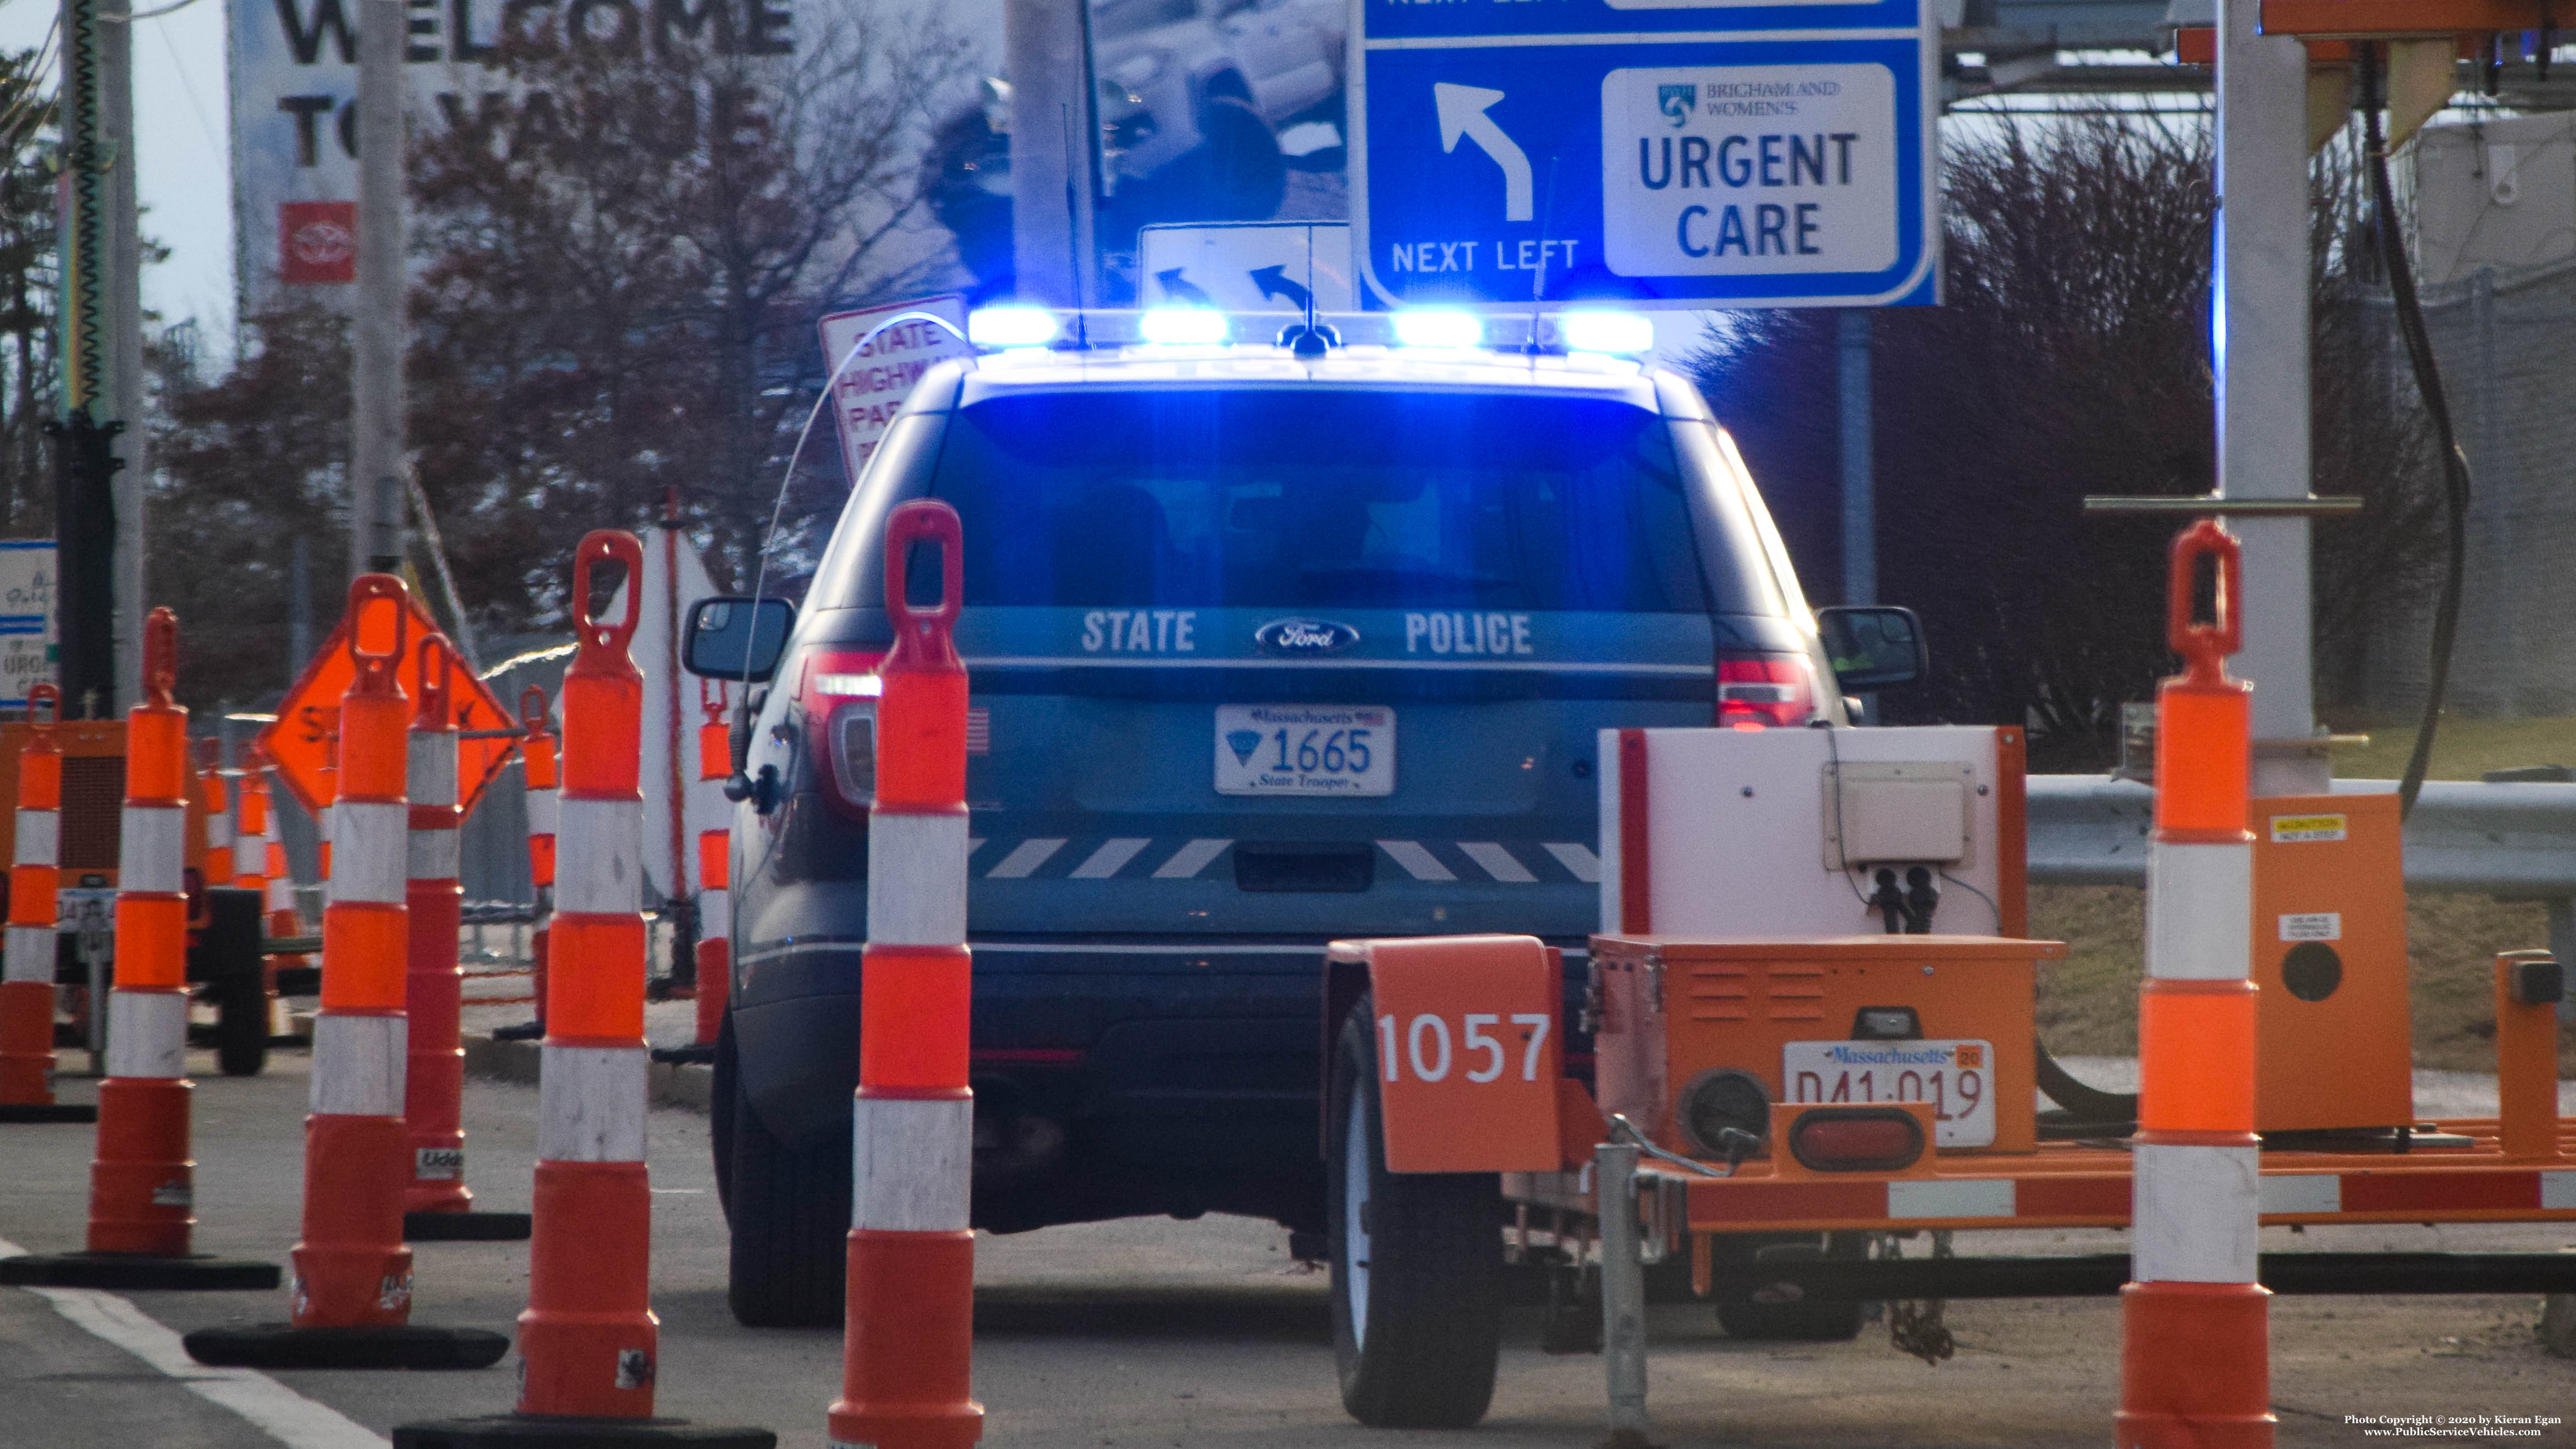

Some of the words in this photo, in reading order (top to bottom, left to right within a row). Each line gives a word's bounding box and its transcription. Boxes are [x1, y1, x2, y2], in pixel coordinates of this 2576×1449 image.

[1707, 81, 1793, 99] BRIGHAM
[1795, 81, 1841, 96] AND
[1707, 101, 1797, 117] WOMEN'S
[1639, 133, 1859, 190] URGENT
[1677, 203, 1823, 258] CARE
[1392, 241, 1479, 273] NEXT
[1496, 239, 1579, 271] LEFT
[854, 319, 942, 357] STATE
[1081, 610, 1197, 652] STATE
[1405, 611, 1533, 655] POLICE
[1279, 624, 1335, 647] Ford
[1258, 708, 1353, 724] Massachusetts
[1272, 728, 1371, 773] 1665
[1259, 772, 1293, 787] State
[1298, 772, 1351, 789] Trooper
[1378, 1013, 1551, 1083] 1057
[1832, 1046, 1947, 1065] Massachusetts
[1959, 1051, 1979, 1066] 20
